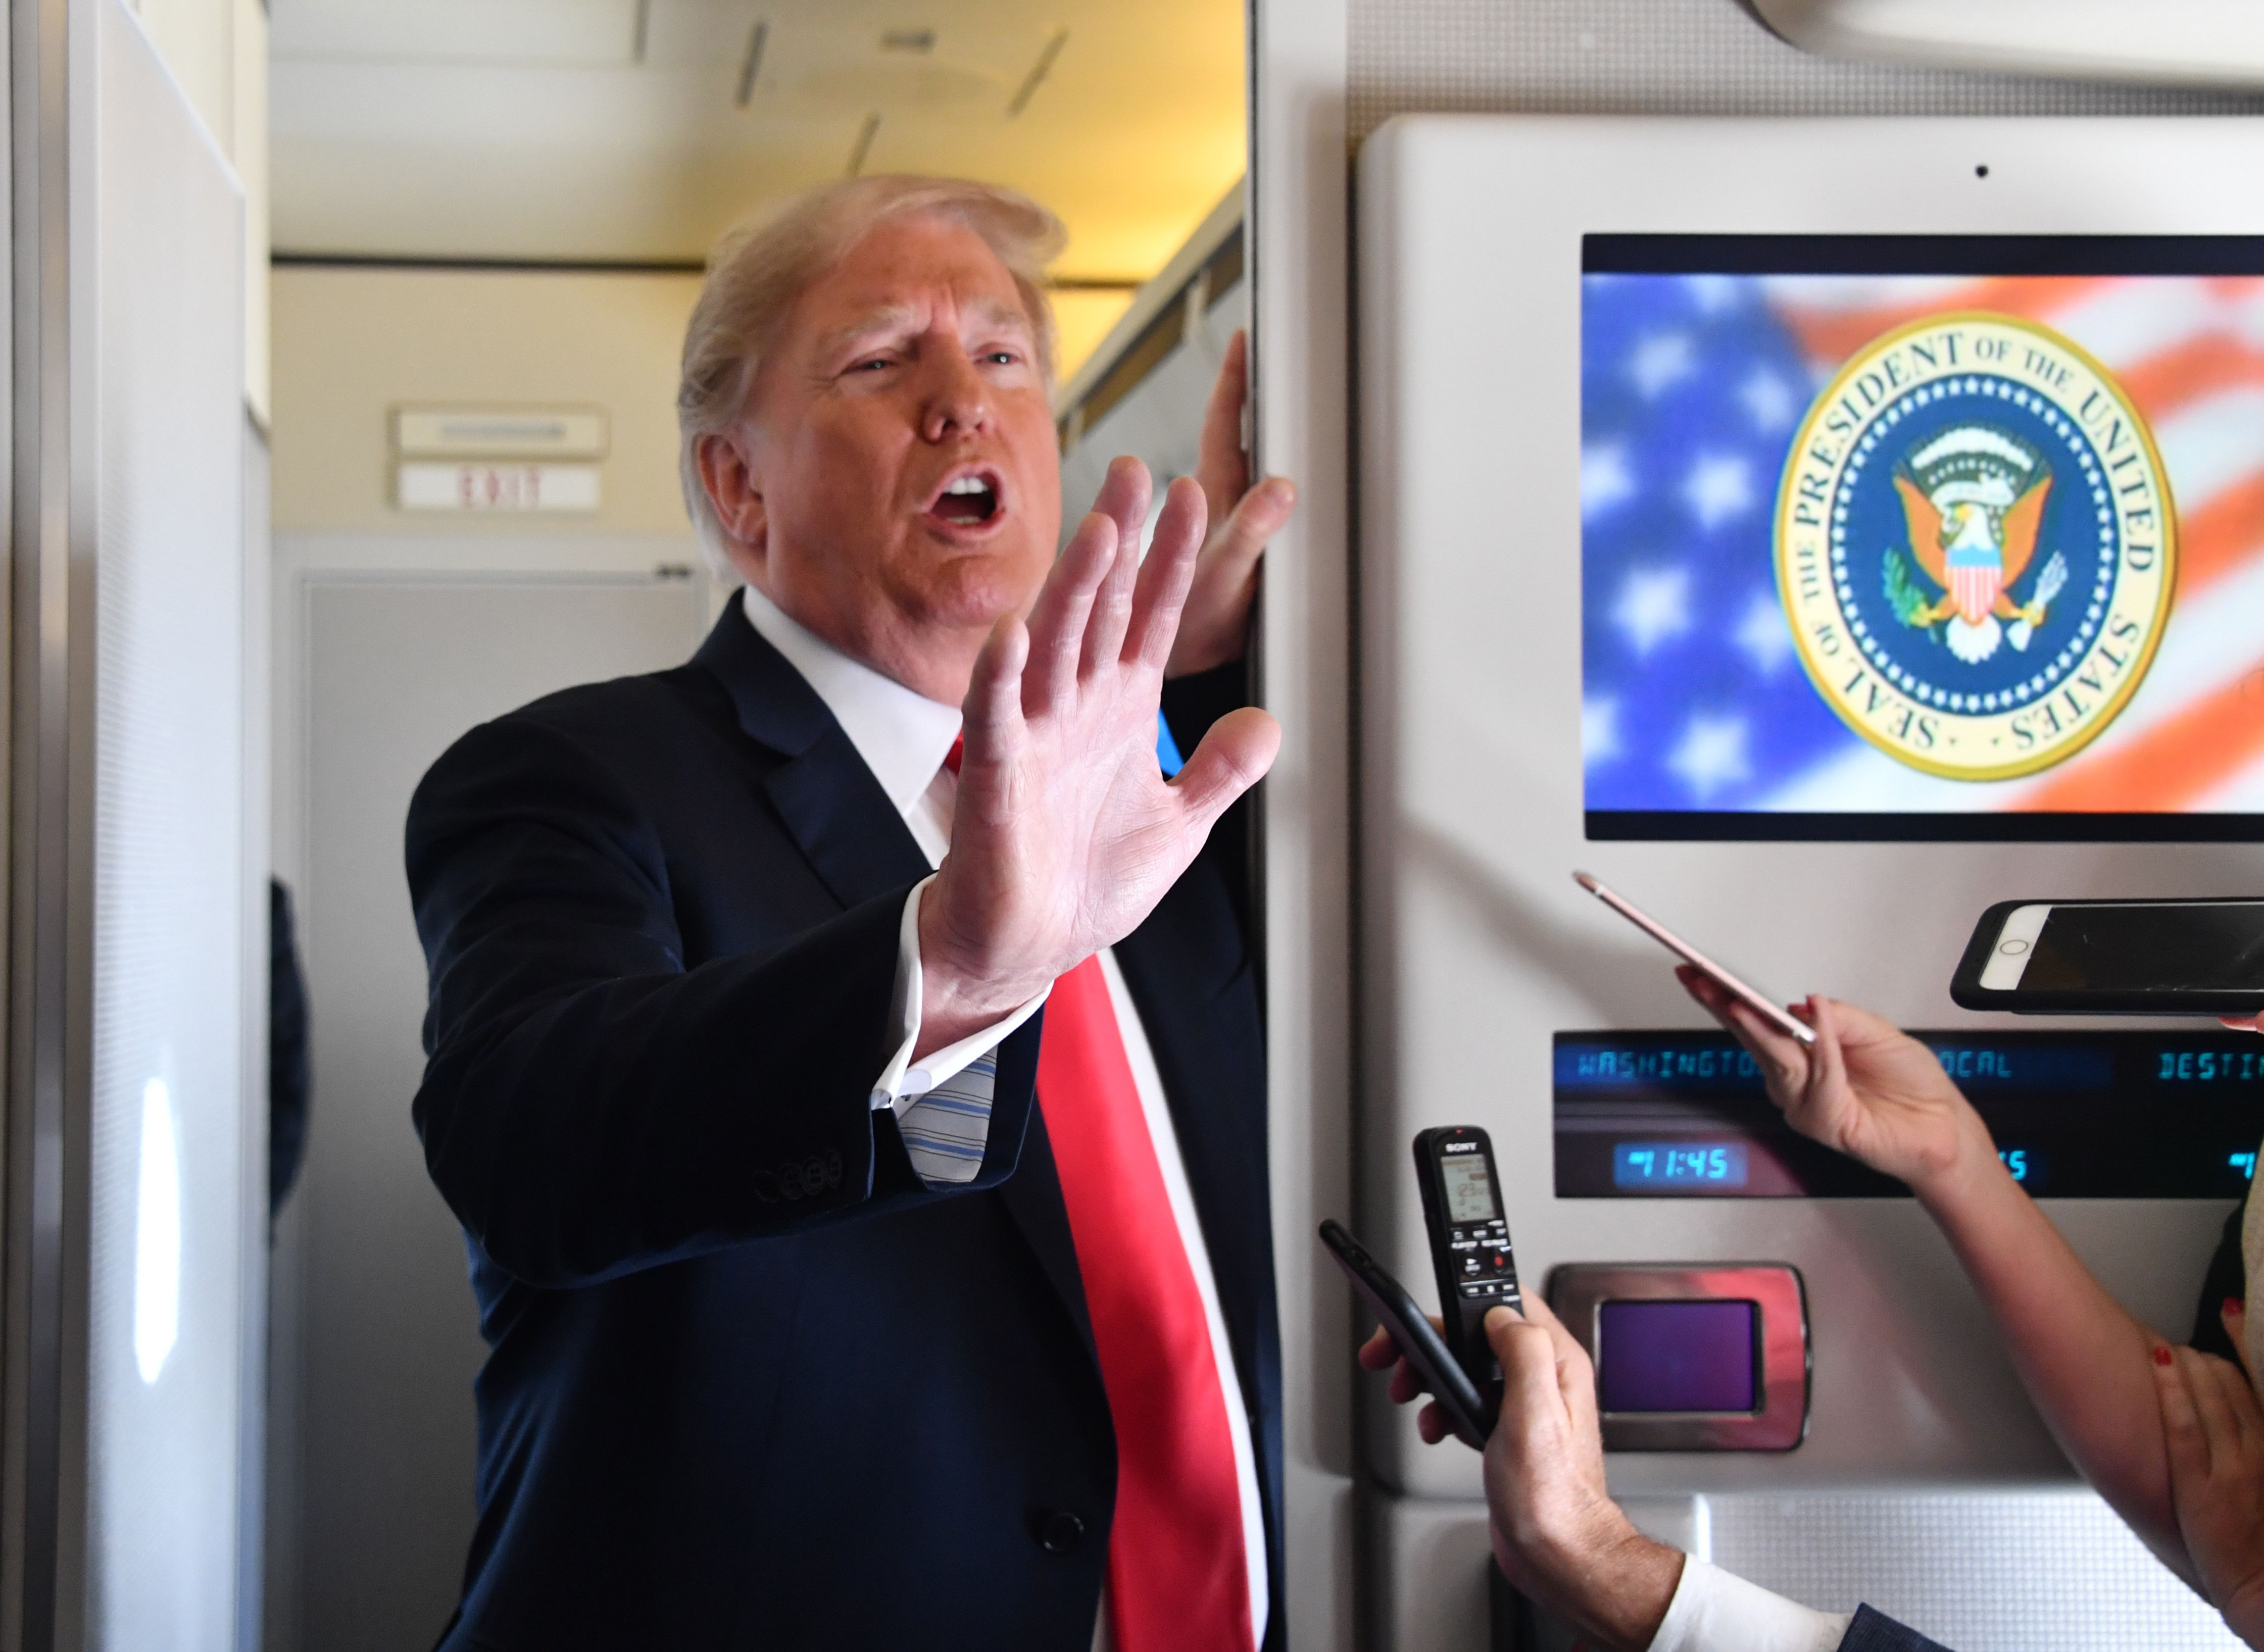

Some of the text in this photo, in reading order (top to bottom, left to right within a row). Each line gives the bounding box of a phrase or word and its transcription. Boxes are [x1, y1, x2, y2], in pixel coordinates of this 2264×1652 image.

[1794, 333, 2154, 749] SEAL OF THE PRESIDENT OF THE UNITED STATES
[1578, 1051, 1763, 1079] WASHINGTO
[1938, 1050, 2012, 1078] OCAL
[1445, 1142, 1478, 1152] SONY
